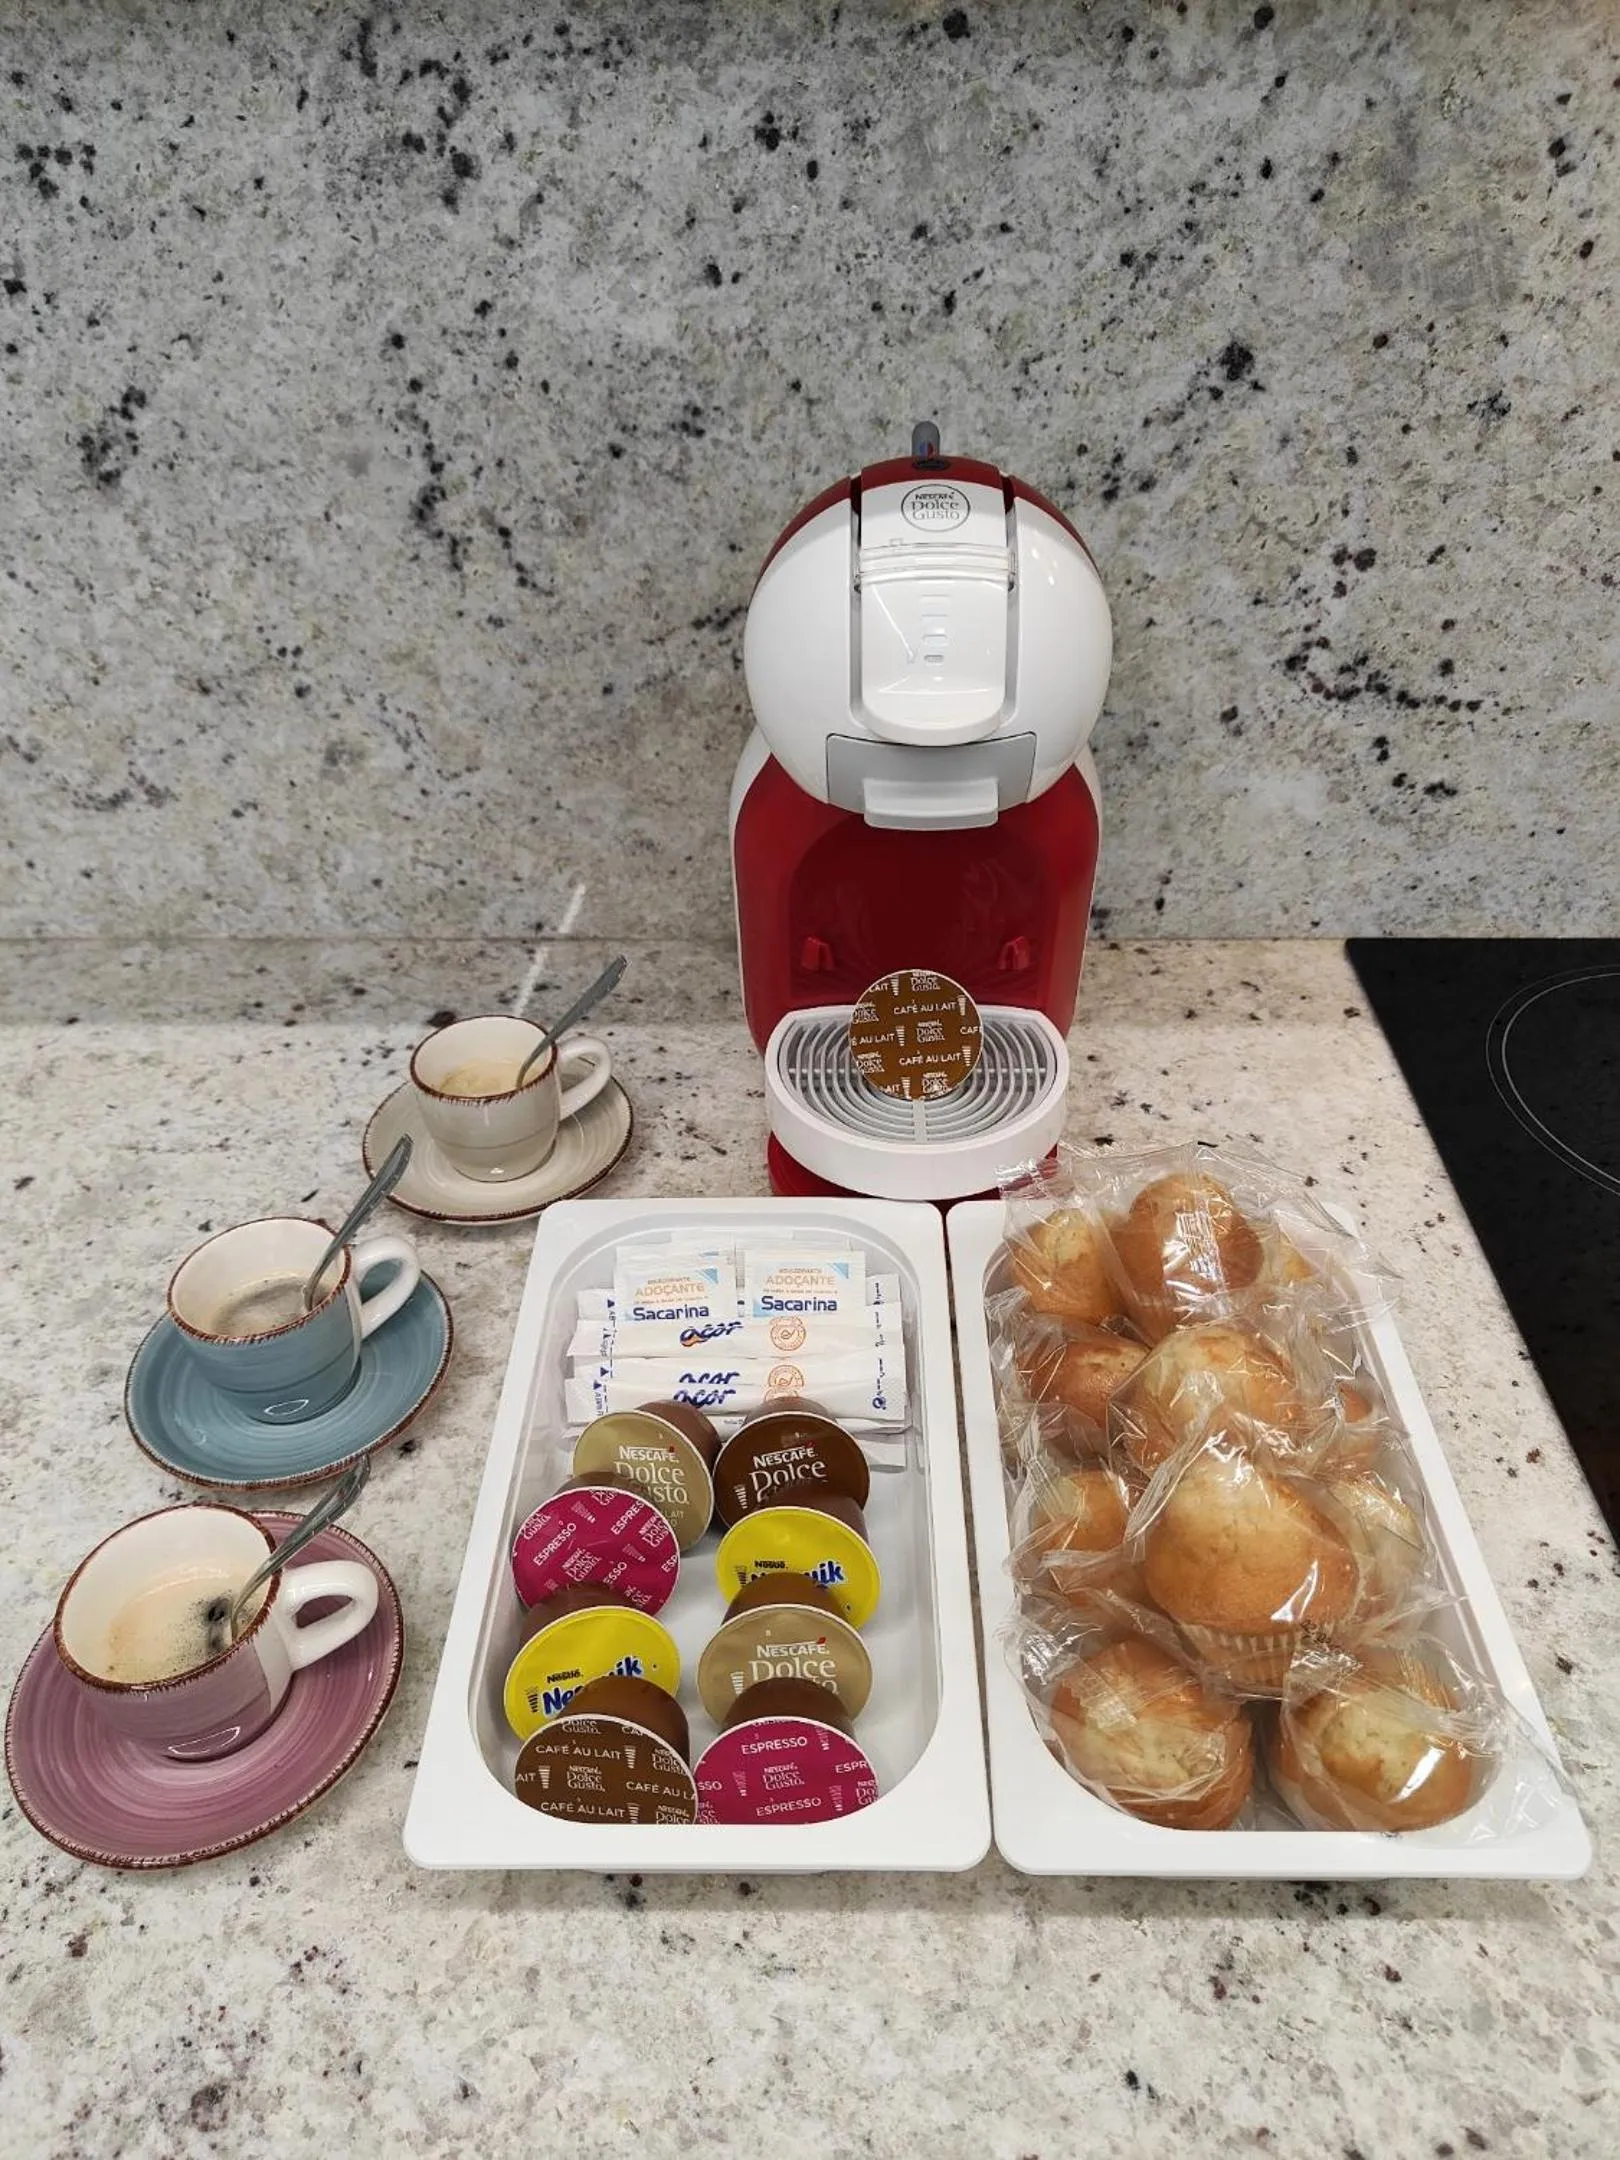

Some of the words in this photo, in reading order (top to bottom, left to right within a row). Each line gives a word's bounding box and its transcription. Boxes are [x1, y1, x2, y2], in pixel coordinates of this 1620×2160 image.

[912, 500, 960, 510] Dolce
[912, 510, 960, 521] Gusto
[920, 1003, 934, 1012] AU
[874, 1033, 895, 1044] LAIT
[925, 1054, 939, 1064] AU
[940, 1052, 962, 1063] LAIT
[761, 1295, 838, 1312] Sacarina
[632, 1303, 710, 1321] Sacarina
[613, 1461, 686, 1487] Dolce
[749, 1459, 829, 1497] Dolce
[532, 1522, 577, 1567] ESPRESSO
[748, 1656, 837, 1682] Dolce
[535, 1744, 570, 1756] CAFÉ
[572, 1746, 592, 1757] AU
[594, 1748, 622, 1760] LAIT
[741, 1736, 808, 1755] ESPRESSO
[566, 1771, 603, 1785] Dolce
[762, 1770, 801, 1784] Dolce
[764, 1777, 806, 1792] Gusto
[566, 1779, 607, 1793] Gusto
[661, 1786, 681, 1798] AU
[576, 1803, 596, 1815] AU
[598, 1806, 626, 1818] LAIT
[755, 1797, 822, 1817] ESPRESSO
